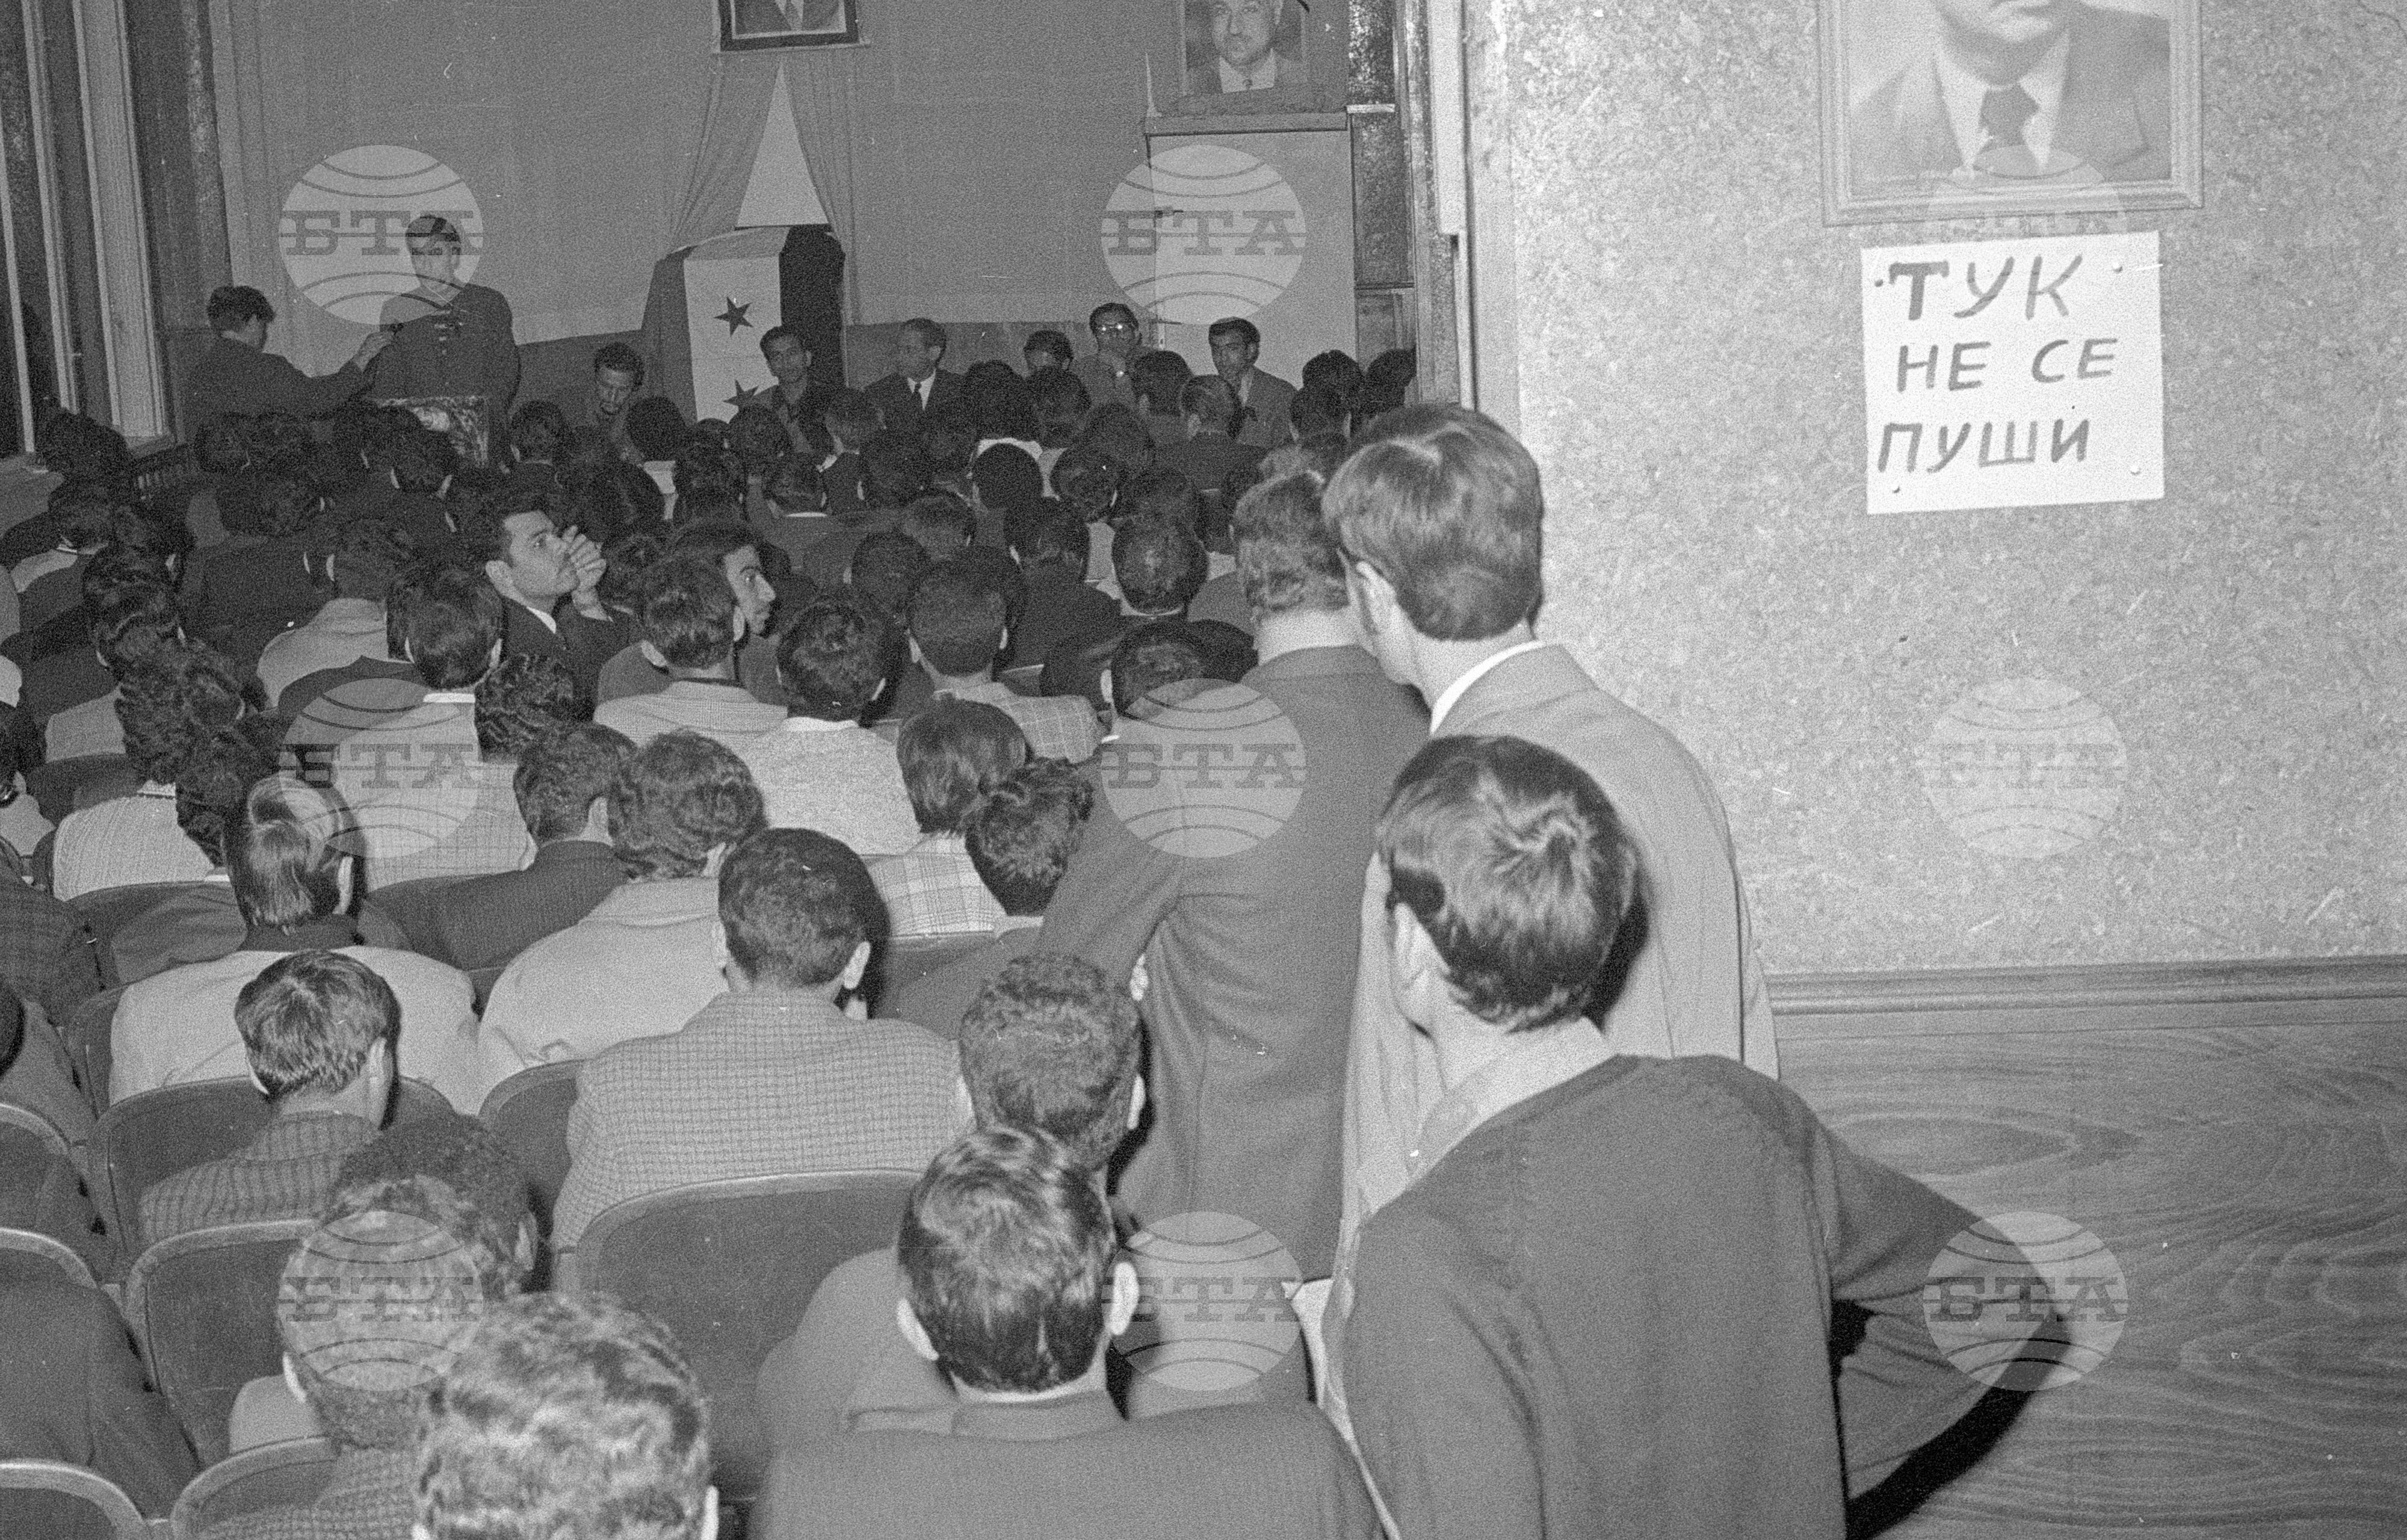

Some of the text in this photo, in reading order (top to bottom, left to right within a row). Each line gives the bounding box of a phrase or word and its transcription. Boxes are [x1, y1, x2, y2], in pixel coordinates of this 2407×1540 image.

[1889, 255, 2082, 321] ТУК
[1897, 338, 2118, 392] НЕ СЕ
[1878, 419, 2089, 472] ПУШИ
